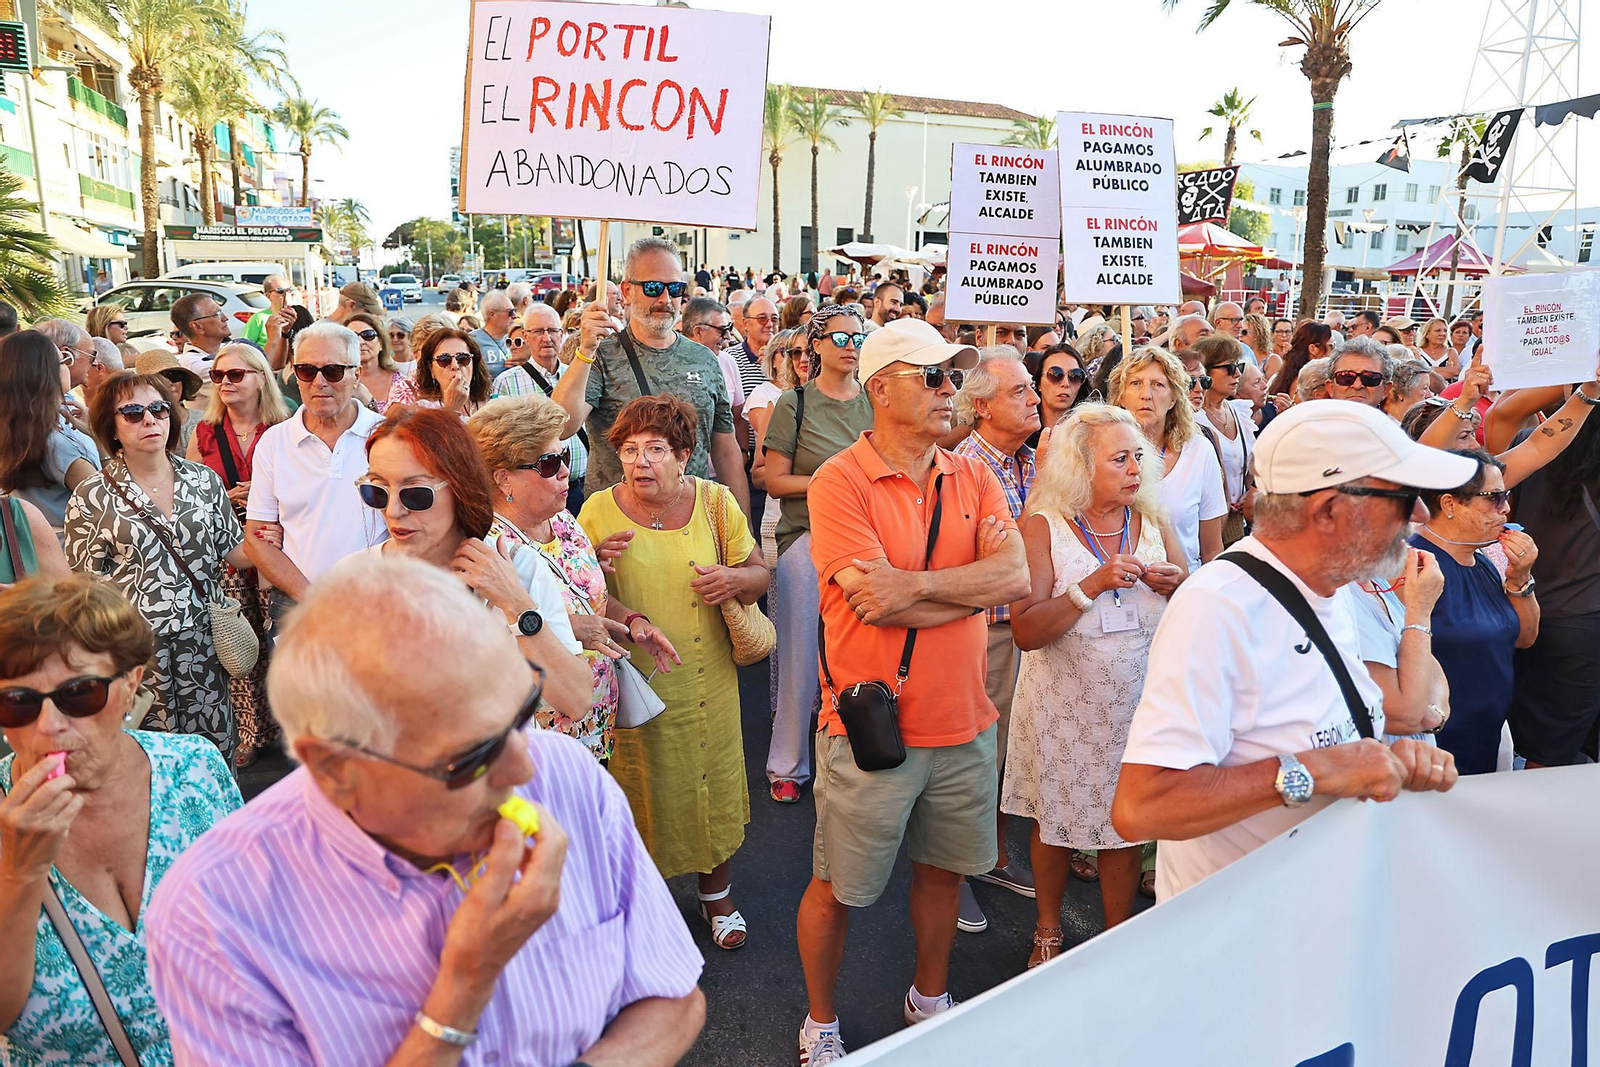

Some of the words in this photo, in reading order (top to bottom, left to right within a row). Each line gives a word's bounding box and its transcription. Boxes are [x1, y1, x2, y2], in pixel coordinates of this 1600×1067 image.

[485, 16, 511, 61] EL
[526, 17, 678, 62] PORTIL
[482, 85, 520, 123] EL
[529, 76, 729, 140] RINCON
[1082, 123, 1095, 134] EL
[1100, 123, 1152, 138] RINCÓN
[1084, 141, 1153, 156] PAGAMOS
[975, 154, 987, 165] EL
[992, 154, 1044, 169] RINCÓN
[1076, 159, 1161, 175] ALUMBRADO
[486, 149, 732, 196] ABANDONADOS
[979, 172, 1036, 186] TAMBIEN
[1093, 176, 1149, 191] PÚBLICO
[979, 206, 1033, 219] ALCALDE
[196, 226, 236, 235] MARISCOS
[237, 227, 247, 235] EL
[247, 227, 290, 236] PELOTAZO
[1087, 218, 1100, 229] EL
[1105, 216, 1157, 231] RINCÓN
[971, 243, 982, 254] EL
[987, 242, 1038, 257] RINCÓN
[1093, 237, 1152, 249] TAMBIEN
[970, 260, 1036, 273] PAGAMOS
[961, 276, 1043, 291] ALUMBRADO
[1096, 273, 1153, 285] ALCALDE
[975, 290, 1028, 306] PÚBLICO
[1524, 305, 1533, 313] EL
[1517, 315, 1548, 325] TAMBIEN
